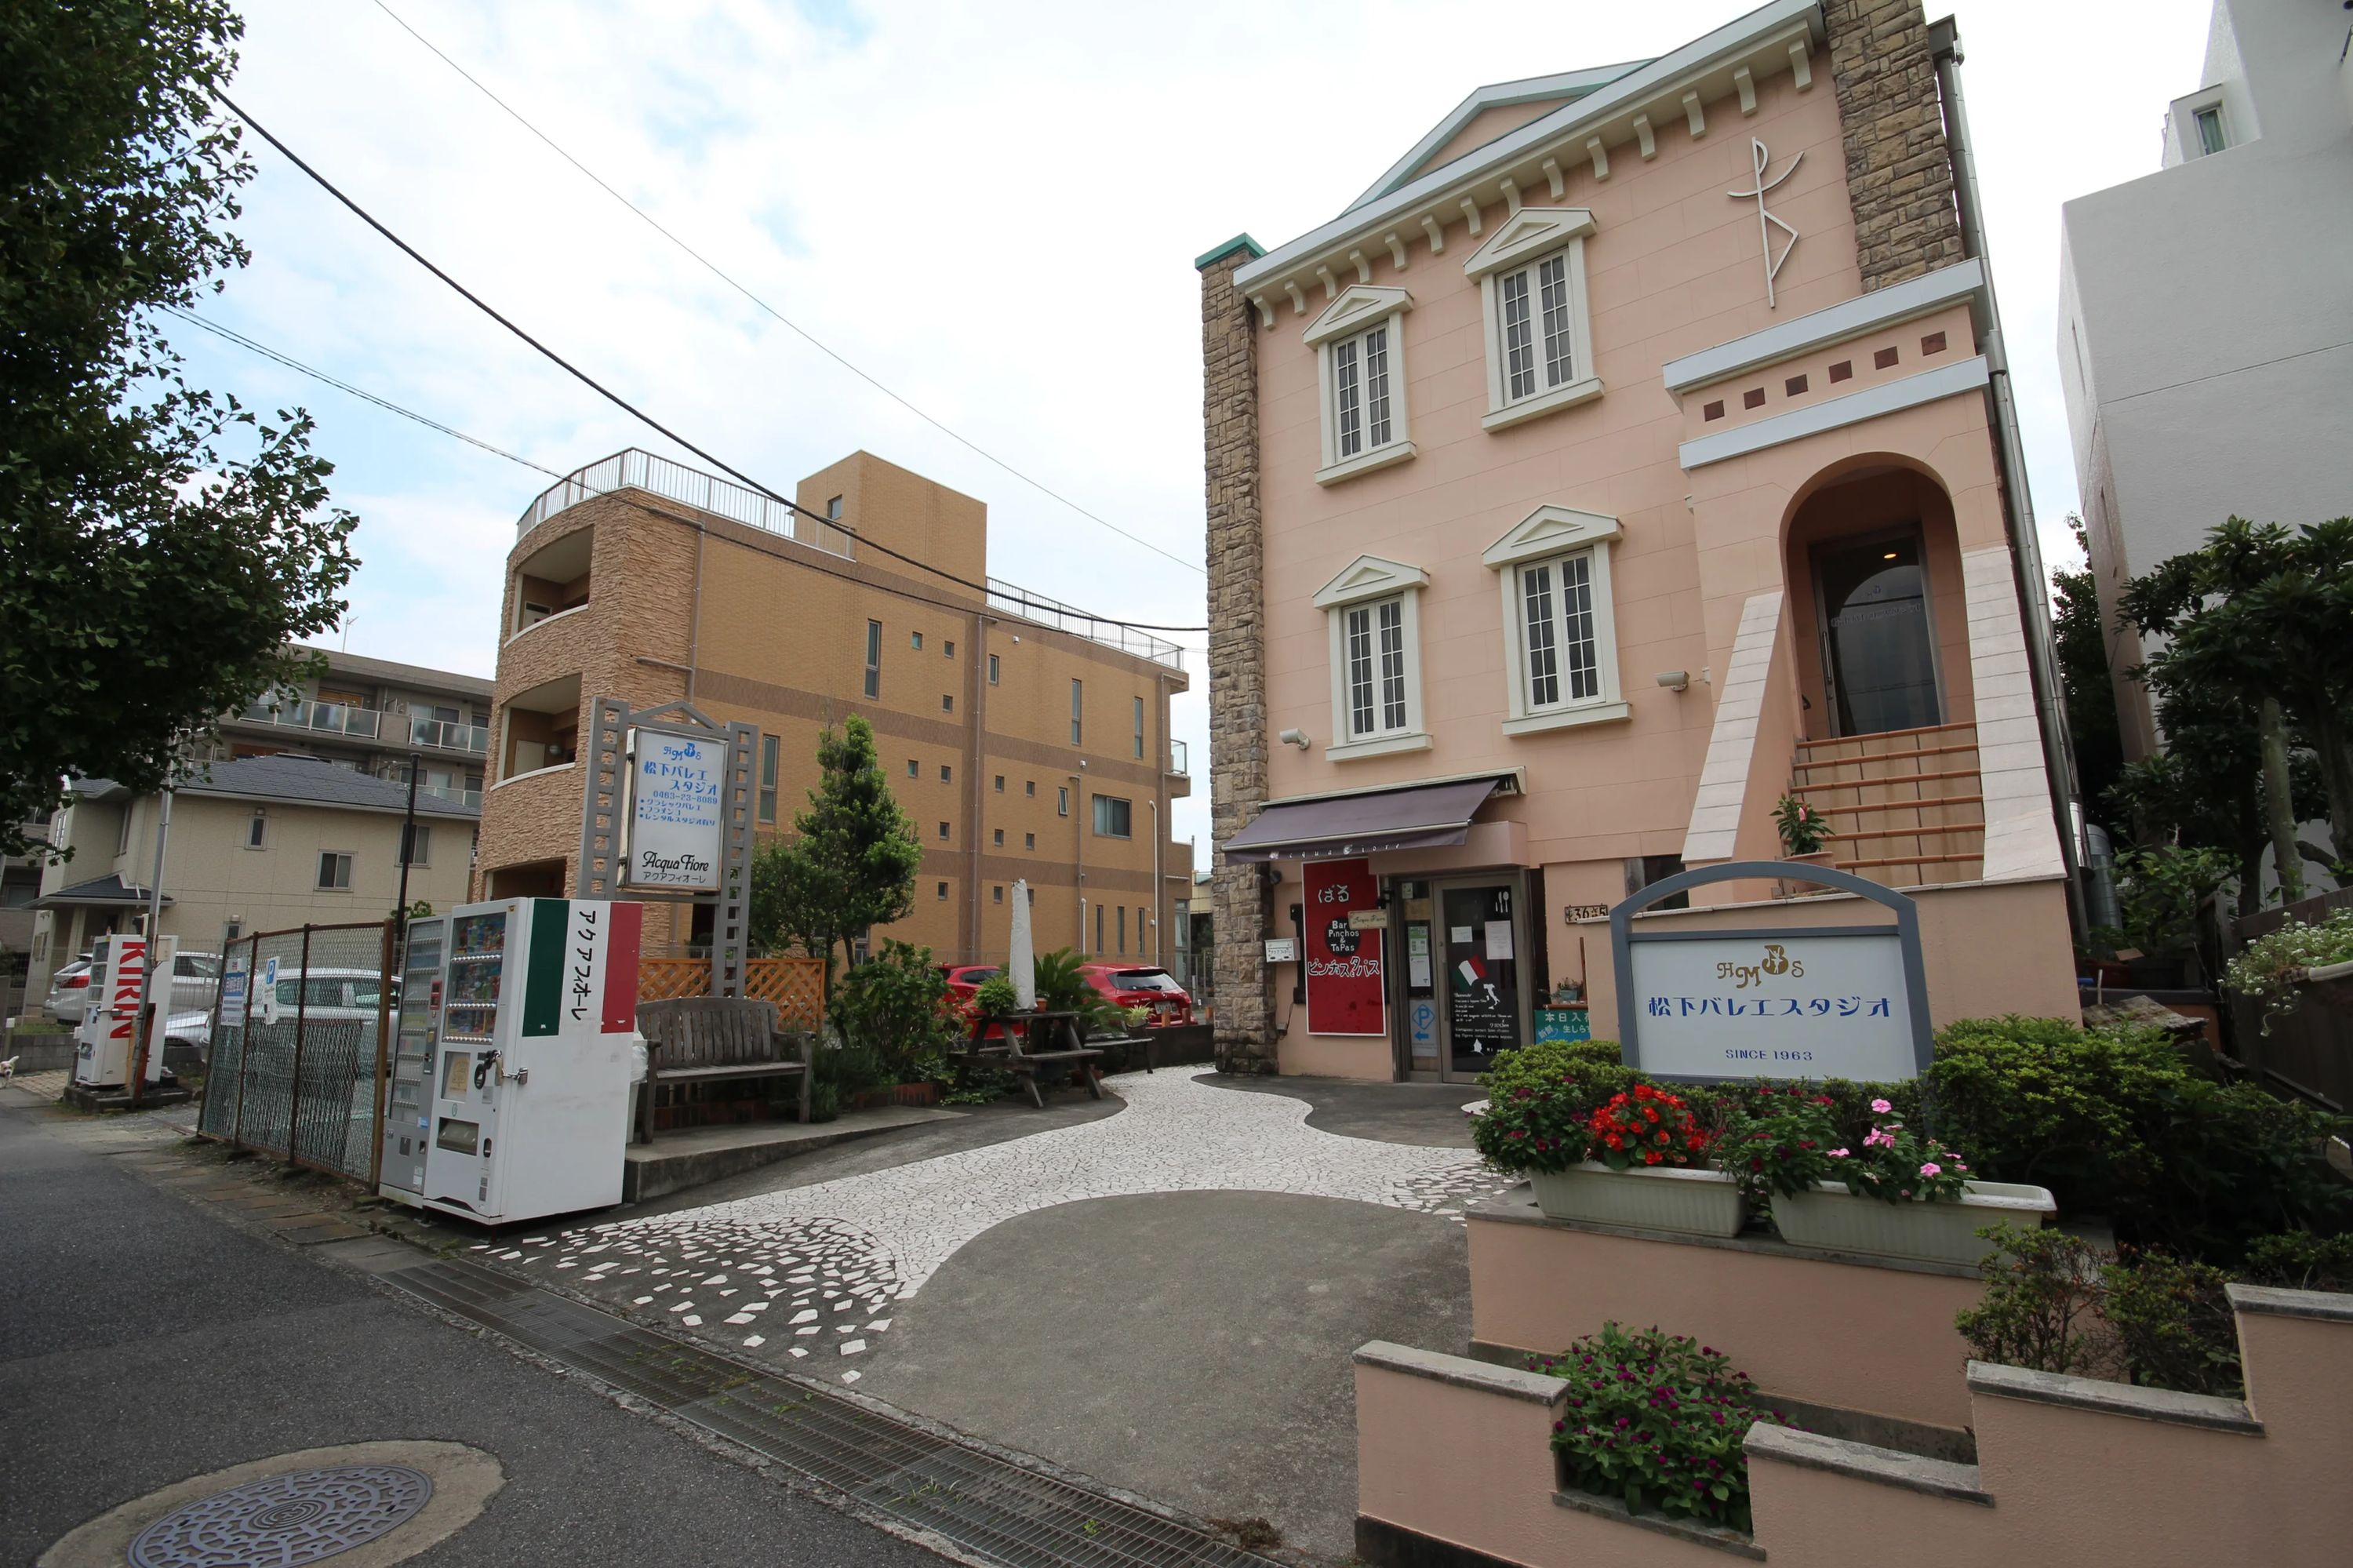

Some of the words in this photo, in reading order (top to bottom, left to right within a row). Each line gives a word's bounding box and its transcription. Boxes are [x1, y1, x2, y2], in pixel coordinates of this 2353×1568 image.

[643, 761, 708, 781] 松下バレエ
[670, 779, 718, 796] スタジオ
[653, 790, 718, 804] 0463-23-8089
[646, 806, 681, 816] フラメンコ
[647, 799, 701, 811] クラシックバレエ
[642, 851, 680, 872] Acqua
[680, 854, 709, 871] Fiore
[643, 871, 707, 884] アクアフィオーレ
[1318, 884, 1349, 904] ばる
[1332, 920, 1347, 930] Bar
[1328, 930, 1360, 938] Pinchos
[571, 910, 596, 1020] アクアフィオーレ
[1649, 996, 1891, 1017] 松下バレエスタジオ
[1417, 1006, 1430, 1026] P
[1726, 1049, 1767, 1060] SINCE
[1773, 1050, 1813, 1061] 1963
